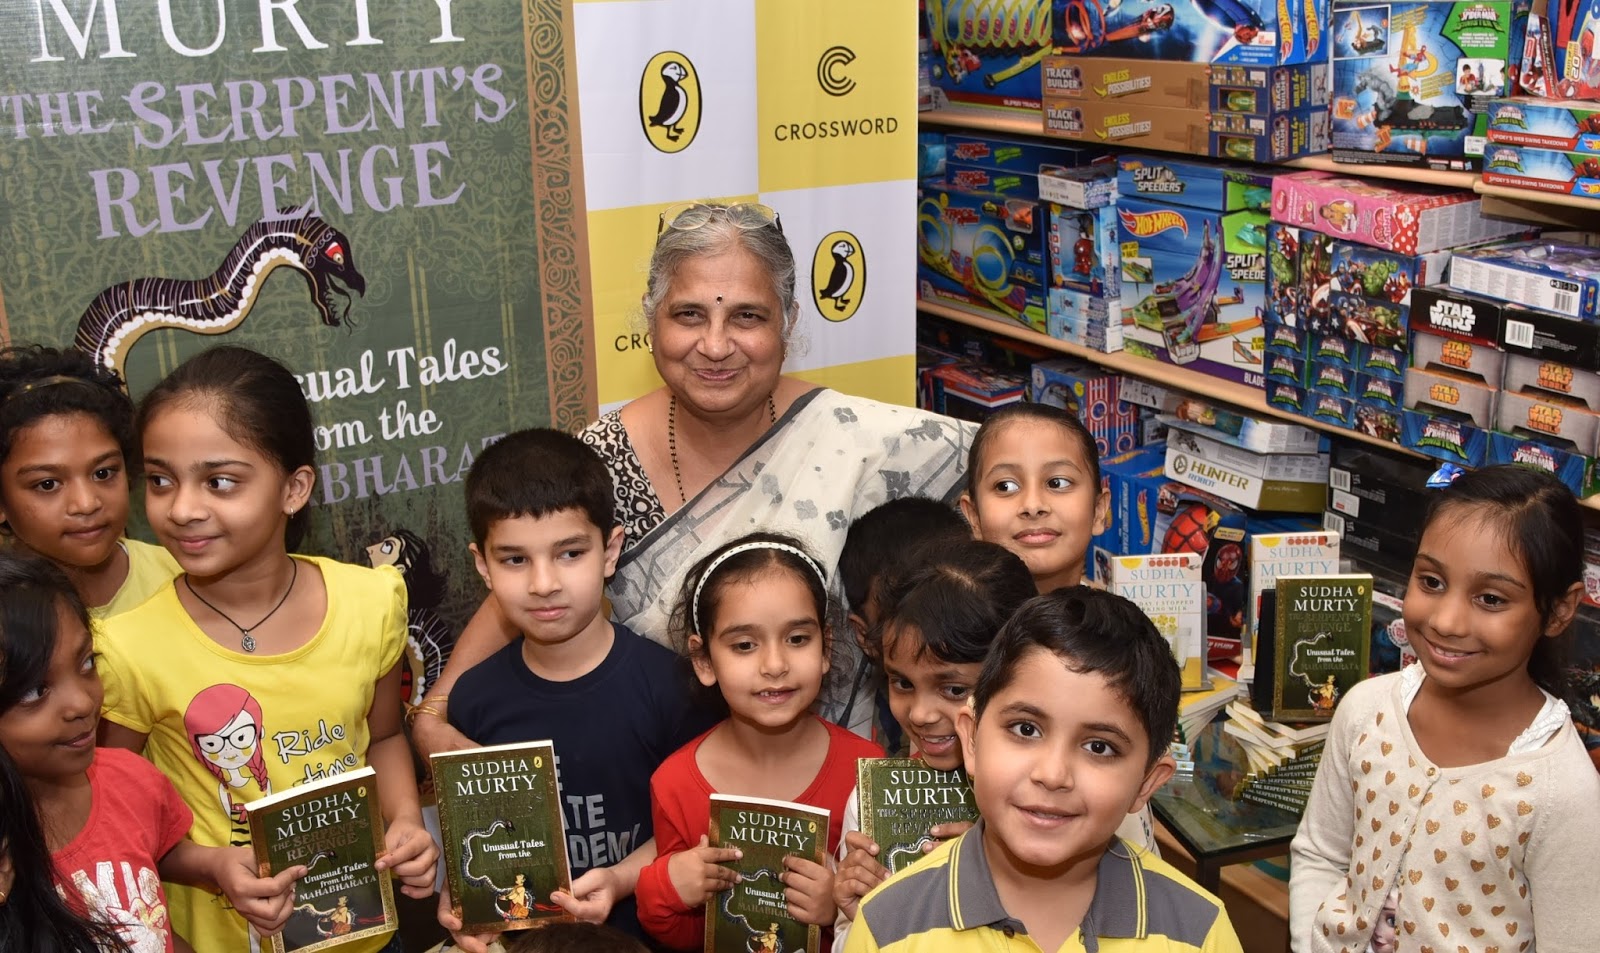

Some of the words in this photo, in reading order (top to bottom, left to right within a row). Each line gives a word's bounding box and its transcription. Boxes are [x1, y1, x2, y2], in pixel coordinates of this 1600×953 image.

[1046, 68, 1072, 78] TRACK
[1047, 79, 1079, 89] BUILDER
[2, 90, 116, 140] THE
[122, 63, 518, 149] SERPENT'S
[1047, 109, 1073, 120] TRACK
[774, 117, 898, 142] CROSSWORD
[1048, 120, 1080, 131] BUILDER
[1134, 166, 1163, 181] SPLIT
[88, 141, 467, 239] REVENGE
[1137, 181, 1182, 193] SPEEDERS
[1135, 214, 1155, 235] HOT
[1226, 254, 1259, 268] SPLIT
[1231, 269, 1265, 280] SPEEDE
[1430, 300, 1476, 319] STAR
[1430, 311, 1476, 331] WARS
[388, 338, 508, 390] Tales
[313, 419, 373, 451] om
[378, 400, 443, 440] the
[1187, 473, 1217, 488] ROBOT
[1190, 460, 1249, 490] HUNTER
[1269, 546, 1323, 558] SUDHA
[1130, 568, 1185, 580] SUDHA
[1261, 560, 1332, 577] MURTY
[1122, 583, 1194, 599] MURTY
[1300, 586, 1353, 598] SUDHA
[1294, 599, 1358, 611] MURTY
[1336, 648, 1355, 656] Tales
[272, 719, 345, 764] Ride
[302, 753, 357, 784] time
[461, 759, 529, 778] SUDHA
[890, 769, 962, 785] SUDHA
[455, 774, 537, 796] MURTY
[883, 787, 970, 805] MURTY
[282, 791, 352, 822] SUDHA
[276, 803, 360, 840] MURTY
[737, 811, 803, 833] SUDHA
[271, 839, 292, 852] THE
[293, 818, 369, 847] SERPENT'S
[729, 825, 810, 852] MURTY
[286, 832, 359, 862] REVENGE
[482, 840, 520, 853] Unusual
[520, 839, 546, 849] Tales
[498, 852, 517, 861] from
[518, 850, 532, 858] the
[304, 867, 342, 884] Unusual
[342, 862, 369, 871] Tales
[320, 878, 340, 888] from
[341, 873, 355, 881] the
[299, 874, 377, 902] MAHABHARATA
[745, 886, 780, 899] Unusual
[758, 897, 776, 908] from
